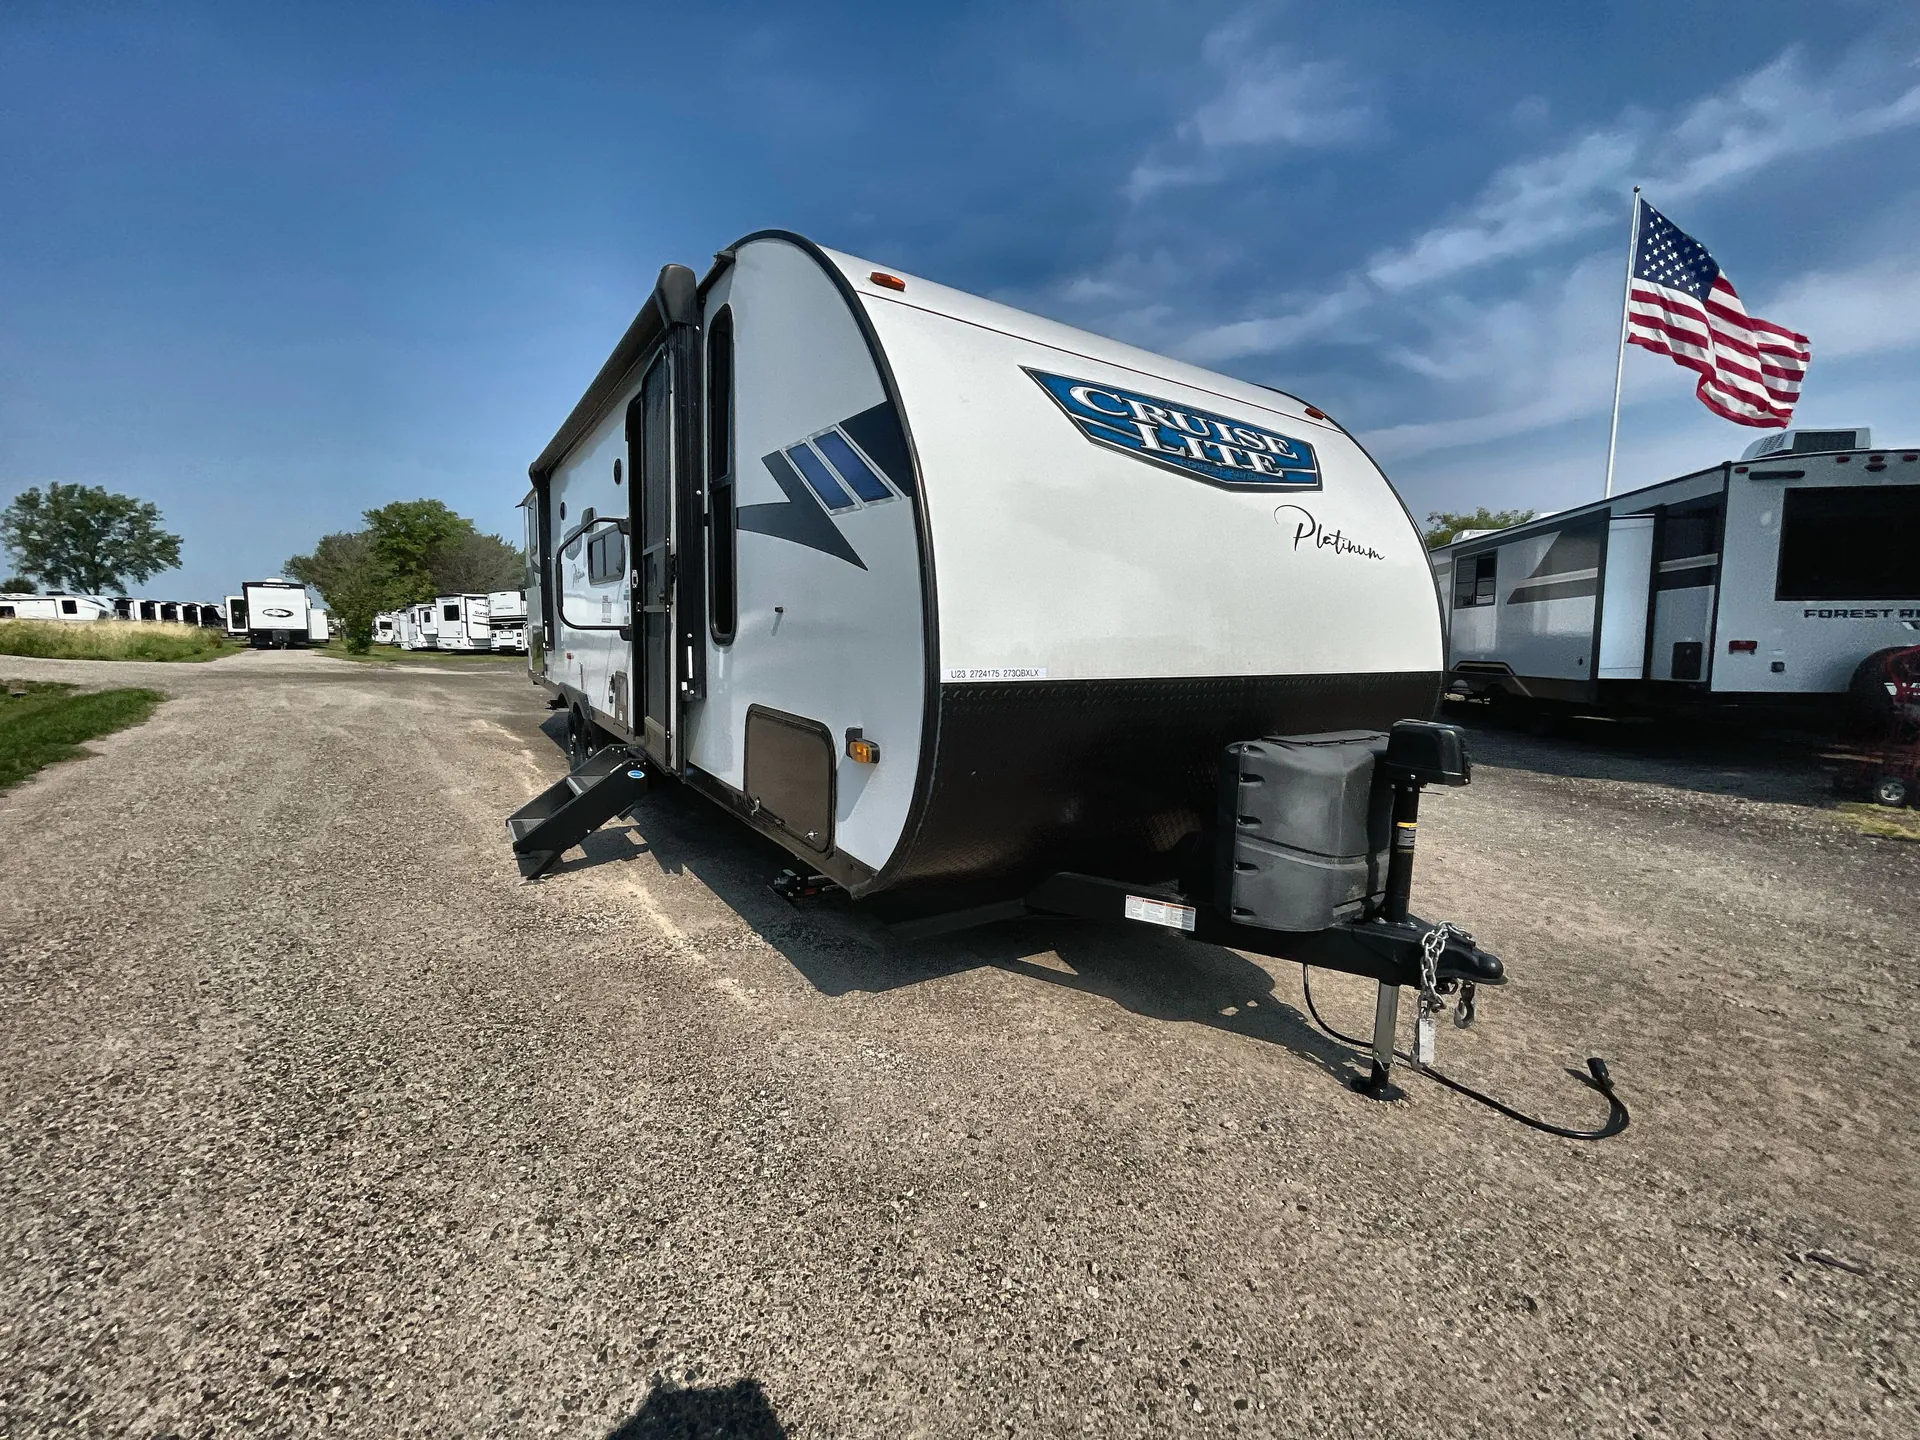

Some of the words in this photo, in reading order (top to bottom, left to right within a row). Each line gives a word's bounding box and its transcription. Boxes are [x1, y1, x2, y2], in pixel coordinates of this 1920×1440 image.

[1069, 386, 1299, 459] CRUISE
[1129, 420, 1284, 478] LITE
[1273, 504, 1386, 560] Platinum
[1803, 608, 1894, 618] FOREST
[950, 669, 966, 679] U23
[969, 669, 1000, 678] 2724175
